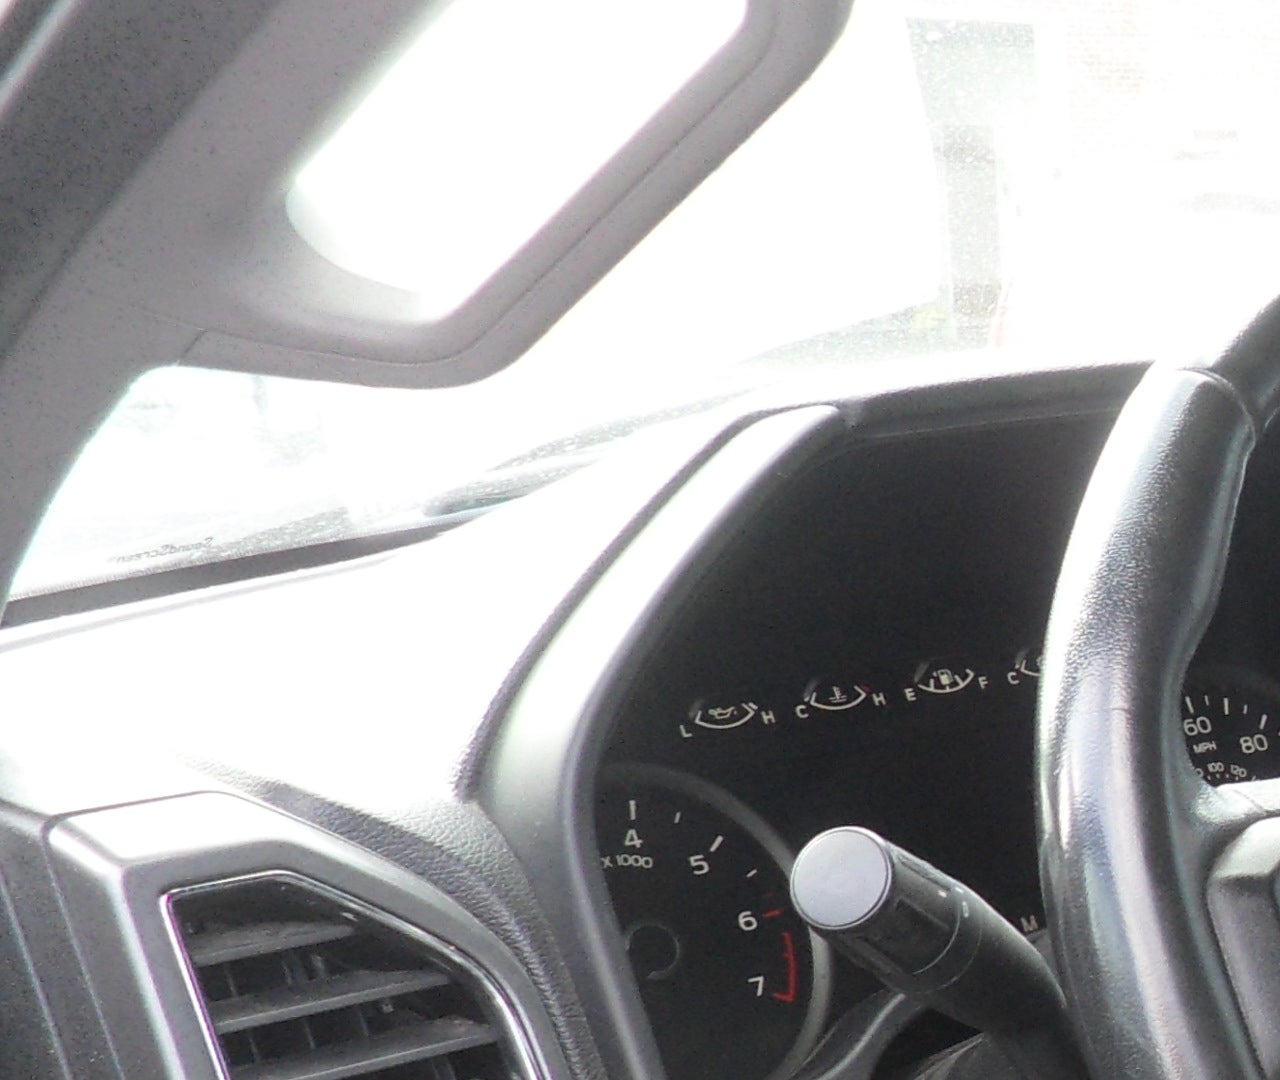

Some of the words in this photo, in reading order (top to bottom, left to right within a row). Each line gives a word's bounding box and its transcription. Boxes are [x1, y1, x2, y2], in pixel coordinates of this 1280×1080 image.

[977, 675, 990, 689] F
[1007, 671, 1020, 685] C
[872, 692, 886, 706] H
[904, 687, 917, 701] E
[761, 710, 776, 725] H
[795, 705, 809, 719] C
[679, 724, 693, 738] L
[1183, 716, 1212, 736] 60
[1192, 740, 1217, 754] MPH
[1239, 734, 1268, 754] 80
[1206, 762, 1225, 773] 100
[1229, 764, 1248, 778] 120
[624, 829, 643, 848] 4
[616, 854, 654, 869] 1000
[689, 854, 710, 875] 5
[737, 911, 758, 931] 6
[747, 975, 765, 996] 7
